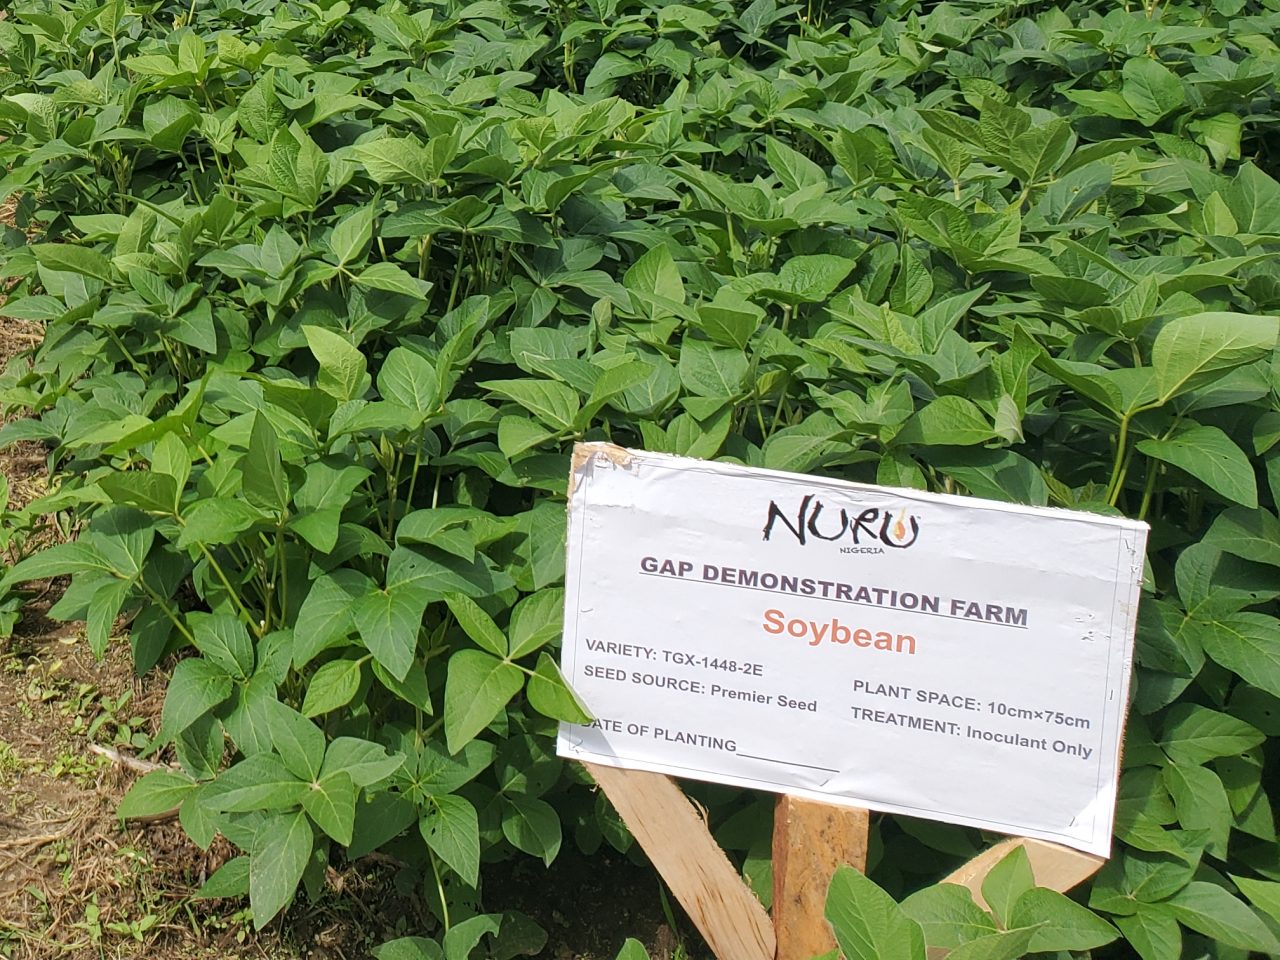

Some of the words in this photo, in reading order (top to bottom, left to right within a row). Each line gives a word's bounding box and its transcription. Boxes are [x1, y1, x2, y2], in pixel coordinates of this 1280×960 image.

[762, 493, 919, 549] NURU
[839, 547, 885, 555] NIGERIA
[640, 555, 694, 577] GAP
[702, 563, 940, 614] DEMONSTRATION
[950, 599, 1028, 626] FARM
[762, 608, 916, 655] Soybean
[585, 638, 657, 661] VARIETY:
[662, 650, 764, 677] TGX-1448-2E
[584, 664, 627, 682] SEED
[631, 672, 706, 695] SOURCE:
[710, 684, 773, 705] Premier
[777, 695, 818, 713] Seed
[853, 679, 911, 700] PLANT
[916, 689, 982, 712] SPACE:
[581, 718, 623, 733] ATE
[627, 723, 649, 737] OF
[851, 706, 961, 736] TREATMENT:
[966, 725, 1047, 751] Inoculant
[1052, 740, 1093, 760] Only
